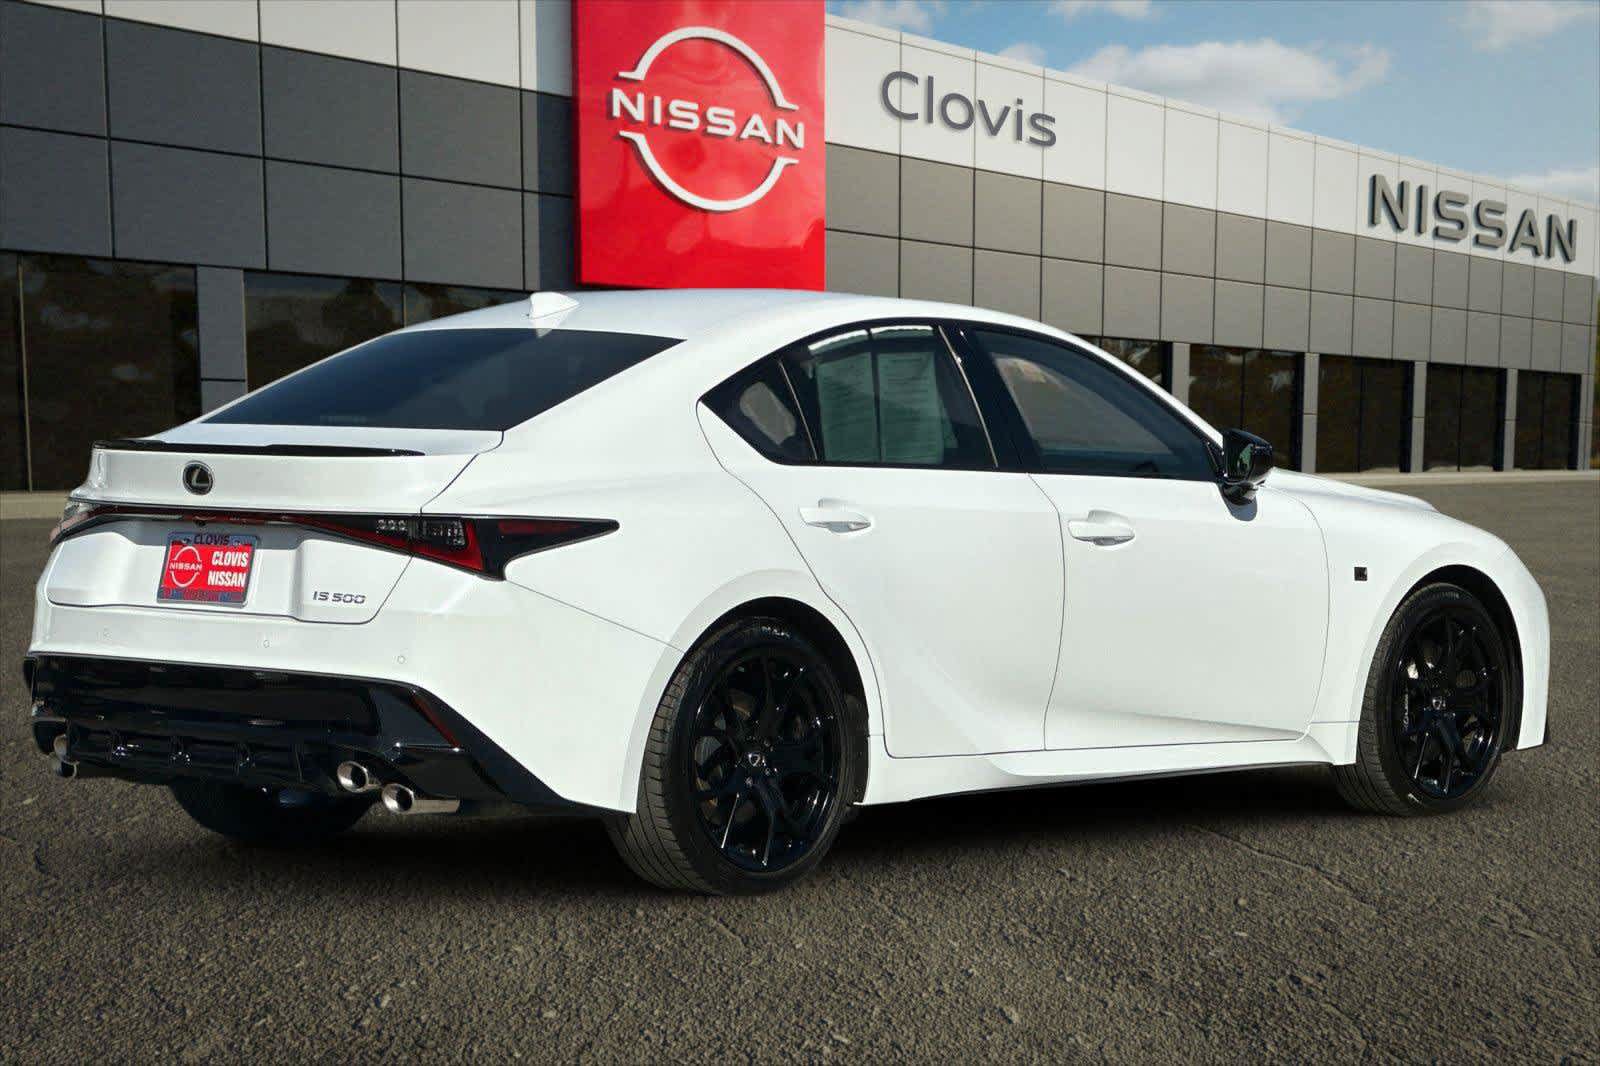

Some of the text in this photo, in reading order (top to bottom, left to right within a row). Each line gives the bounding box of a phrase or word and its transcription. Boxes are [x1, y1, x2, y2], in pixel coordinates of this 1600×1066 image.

[881, 70, 1057, 148] Clovis
[611, 87, 805, 150] NISSAN
[1368, 173, 1578, 264] NISSAN
[193, 533, 230, 546] CLOVIS
[169, 562, 202, 571] NISSAN
[211, 551, 249, 568] CLOVIS
[207, 570, 247, 588] NISSAN
[312, 591, 367, 604] IS 500
